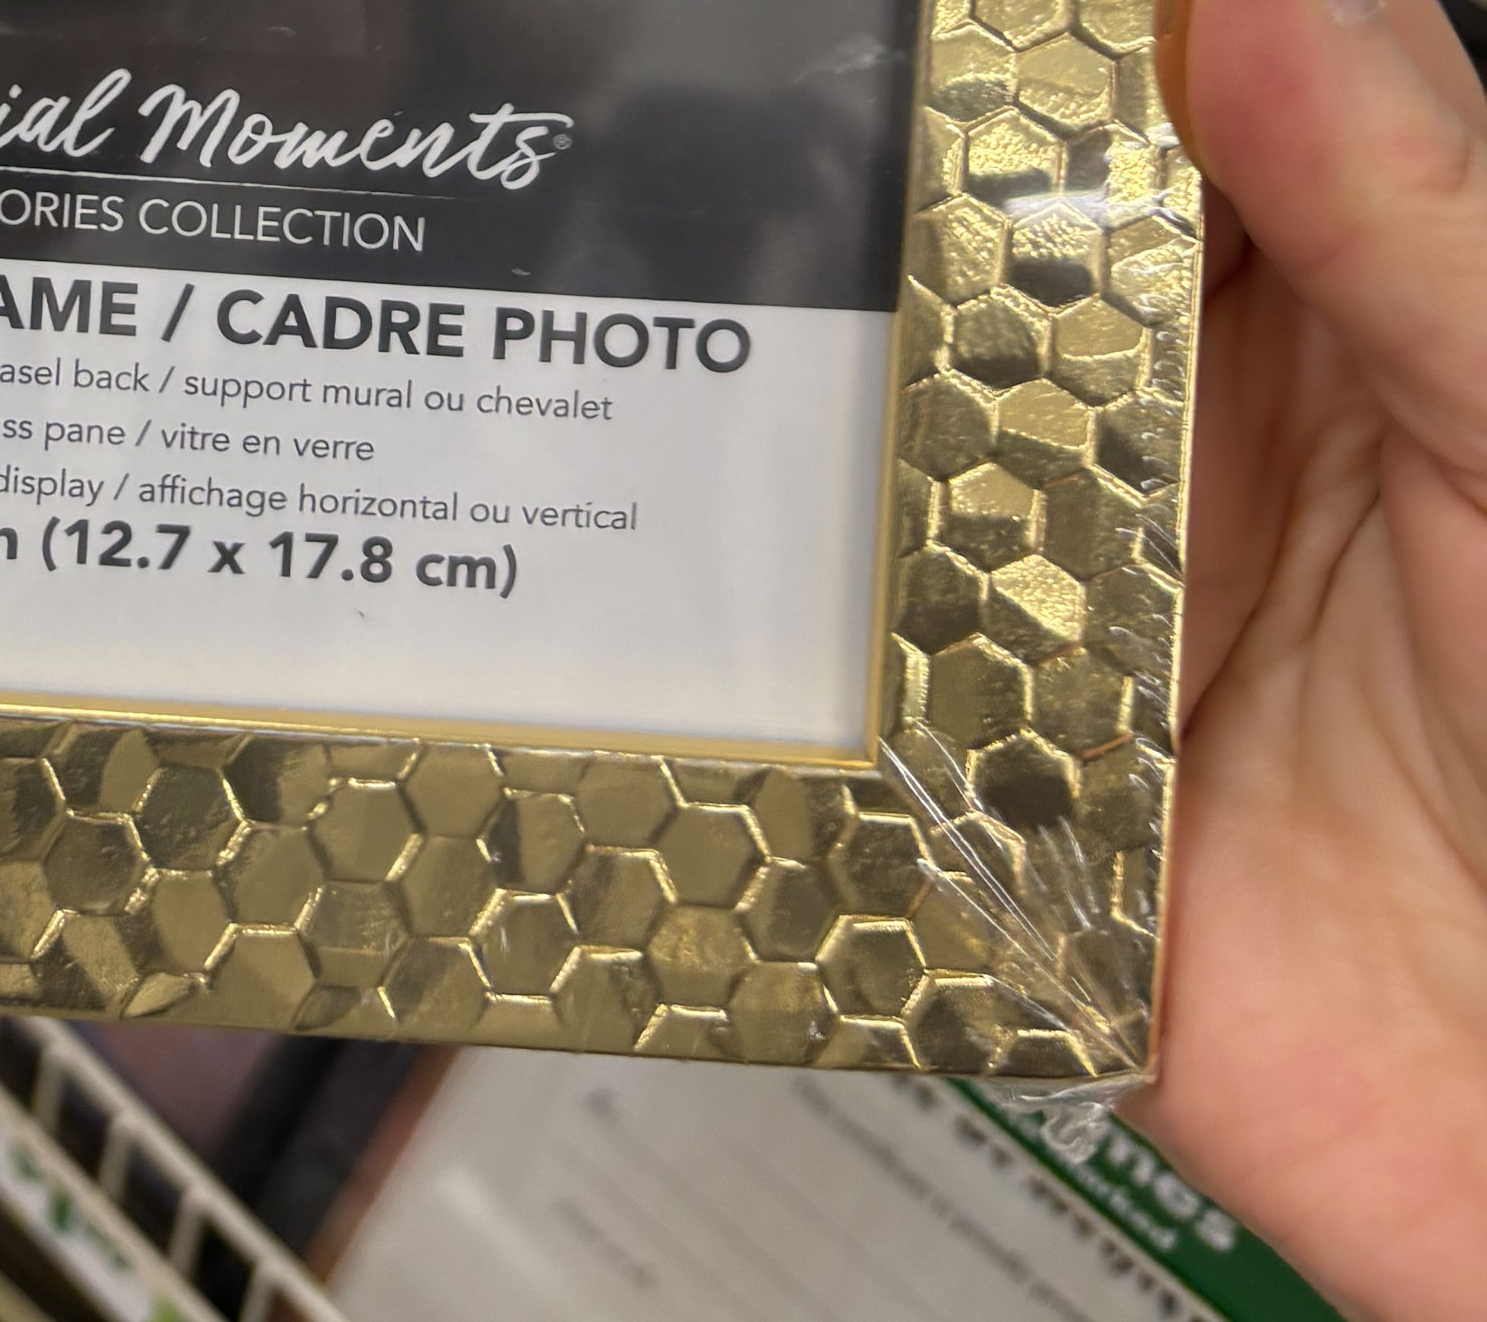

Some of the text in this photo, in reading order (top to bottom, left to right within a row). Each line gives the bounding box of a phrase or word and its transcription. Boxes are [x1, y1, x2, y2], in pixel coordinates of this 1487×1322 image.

[138, 198, 426, 252] COLLECTION
[160, 282, 196, 343] /
[216, 288, 466, 359] CADRE
[492, 306, 752, 374] PHOTO
[72, 357, 151, 393] back
[157, 365, 176, 395] /
[182, 375, 313, 410] support
[322, 378, 413, 409] mural
[423, 390, 466, 412] ou
[476, 384, 613, 421] chevalet
[43, 421, 127, 453] pane
[134, 418, 153, 448] /
[160, 425, 231, 453] vitre
[241, 434, 281, 457] en
[292, 437, 375, 462] verre
[113, 472, 130, 501] /
[138, 473, 288, 518] affichage
[298, 481, 458, 522] horizontal
[469, 503, 511, 525] ou
[521, 501, 638, 531] vertical
[41, 515, 192, 573] (12.7
[207, 540, 246, 575] x
[268, 530, 394, 584] 17.8
[415, 543, 518, 600] cm)
